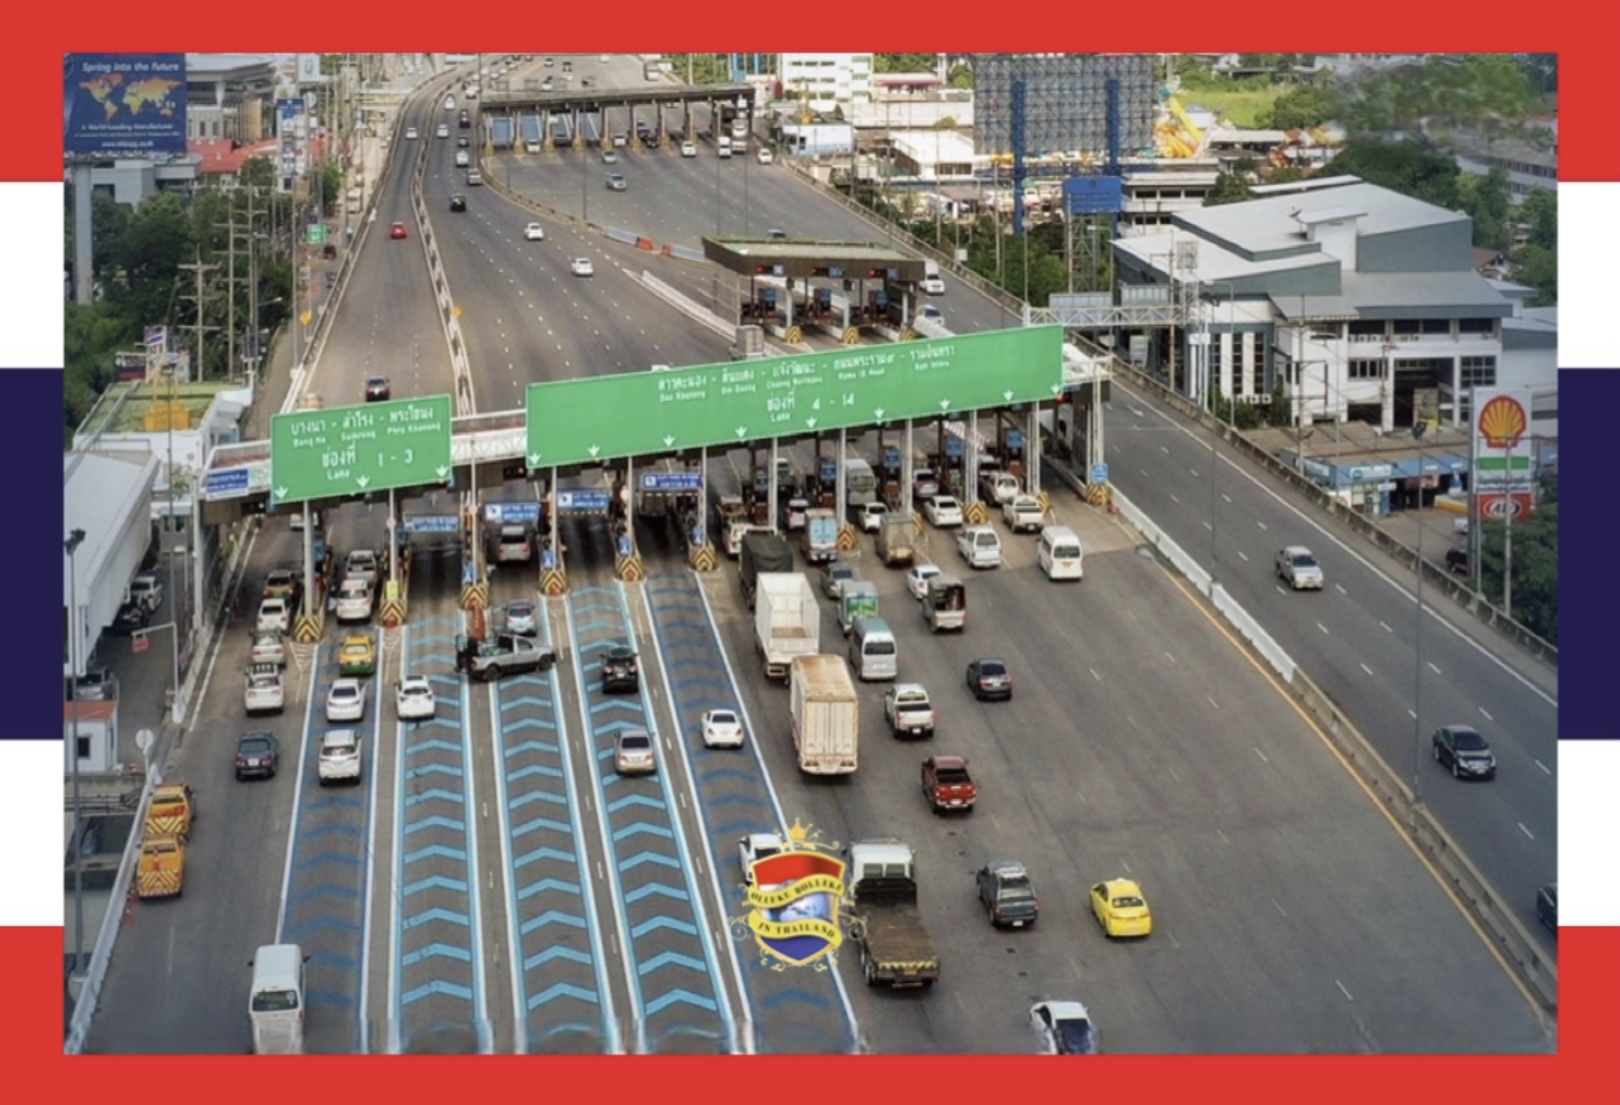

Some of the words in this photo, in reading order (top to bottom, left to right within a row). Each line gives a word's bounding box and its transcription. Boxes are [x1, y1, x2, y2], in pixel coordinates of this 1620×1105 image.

[82, 62, 111, 73] Spring
[114, 63, 132, 71] into
[134, 62, 149, 71] the
[151, 62, 179, 71] Future
[812, 398, 821, 411] 4
[842, 393, 854, 407] 14
[291, 419, 326, 436] บางนา
[343, 410, 374, 429] สำโรง
[390, 404, 434, 423] พระโขนง
[770, 412, 790, 423] Lane
[293, 438, 313, 448] Bang
[315, 436, 326, 445] Na
[341, 430, 376, 441] Samrong
[387, 426, 405, 436] Phra
[408, 422, 441, 433] Khanong
[322, 440, 356, 468] ช่องที่
[378, 453, 384, 467] 1
[404, 448, 414, 464] 3
[327, 468, 350, 480] Lane
